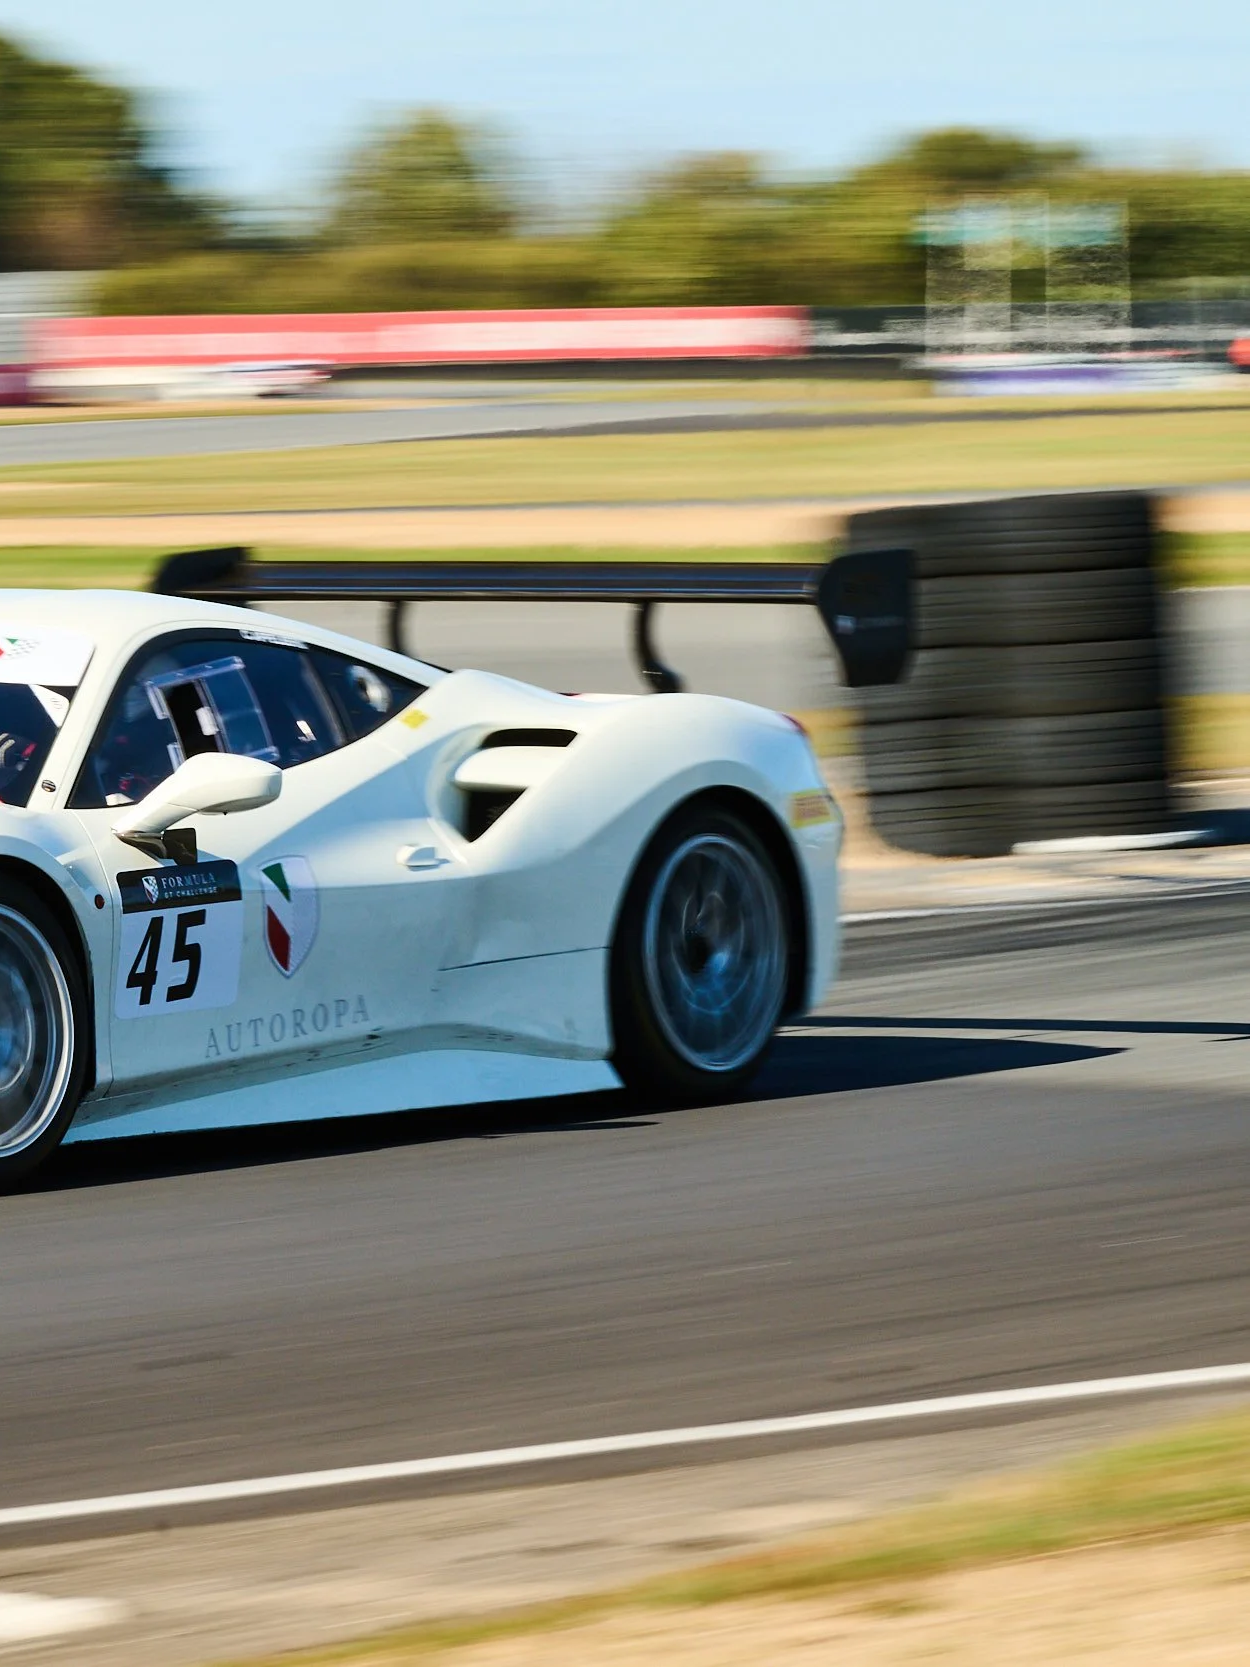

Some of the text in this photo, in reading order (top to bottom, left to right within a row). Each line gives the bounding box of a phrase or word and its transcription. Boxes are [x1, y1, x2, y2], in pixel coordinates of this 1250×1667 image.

[160, 872, 216, 889] FORMULA
[176, 886, 218, 898] CHALLENGE
[126, 908, 206, 1006] 45
[204, 994, 370, 1058] AUTOROPA
